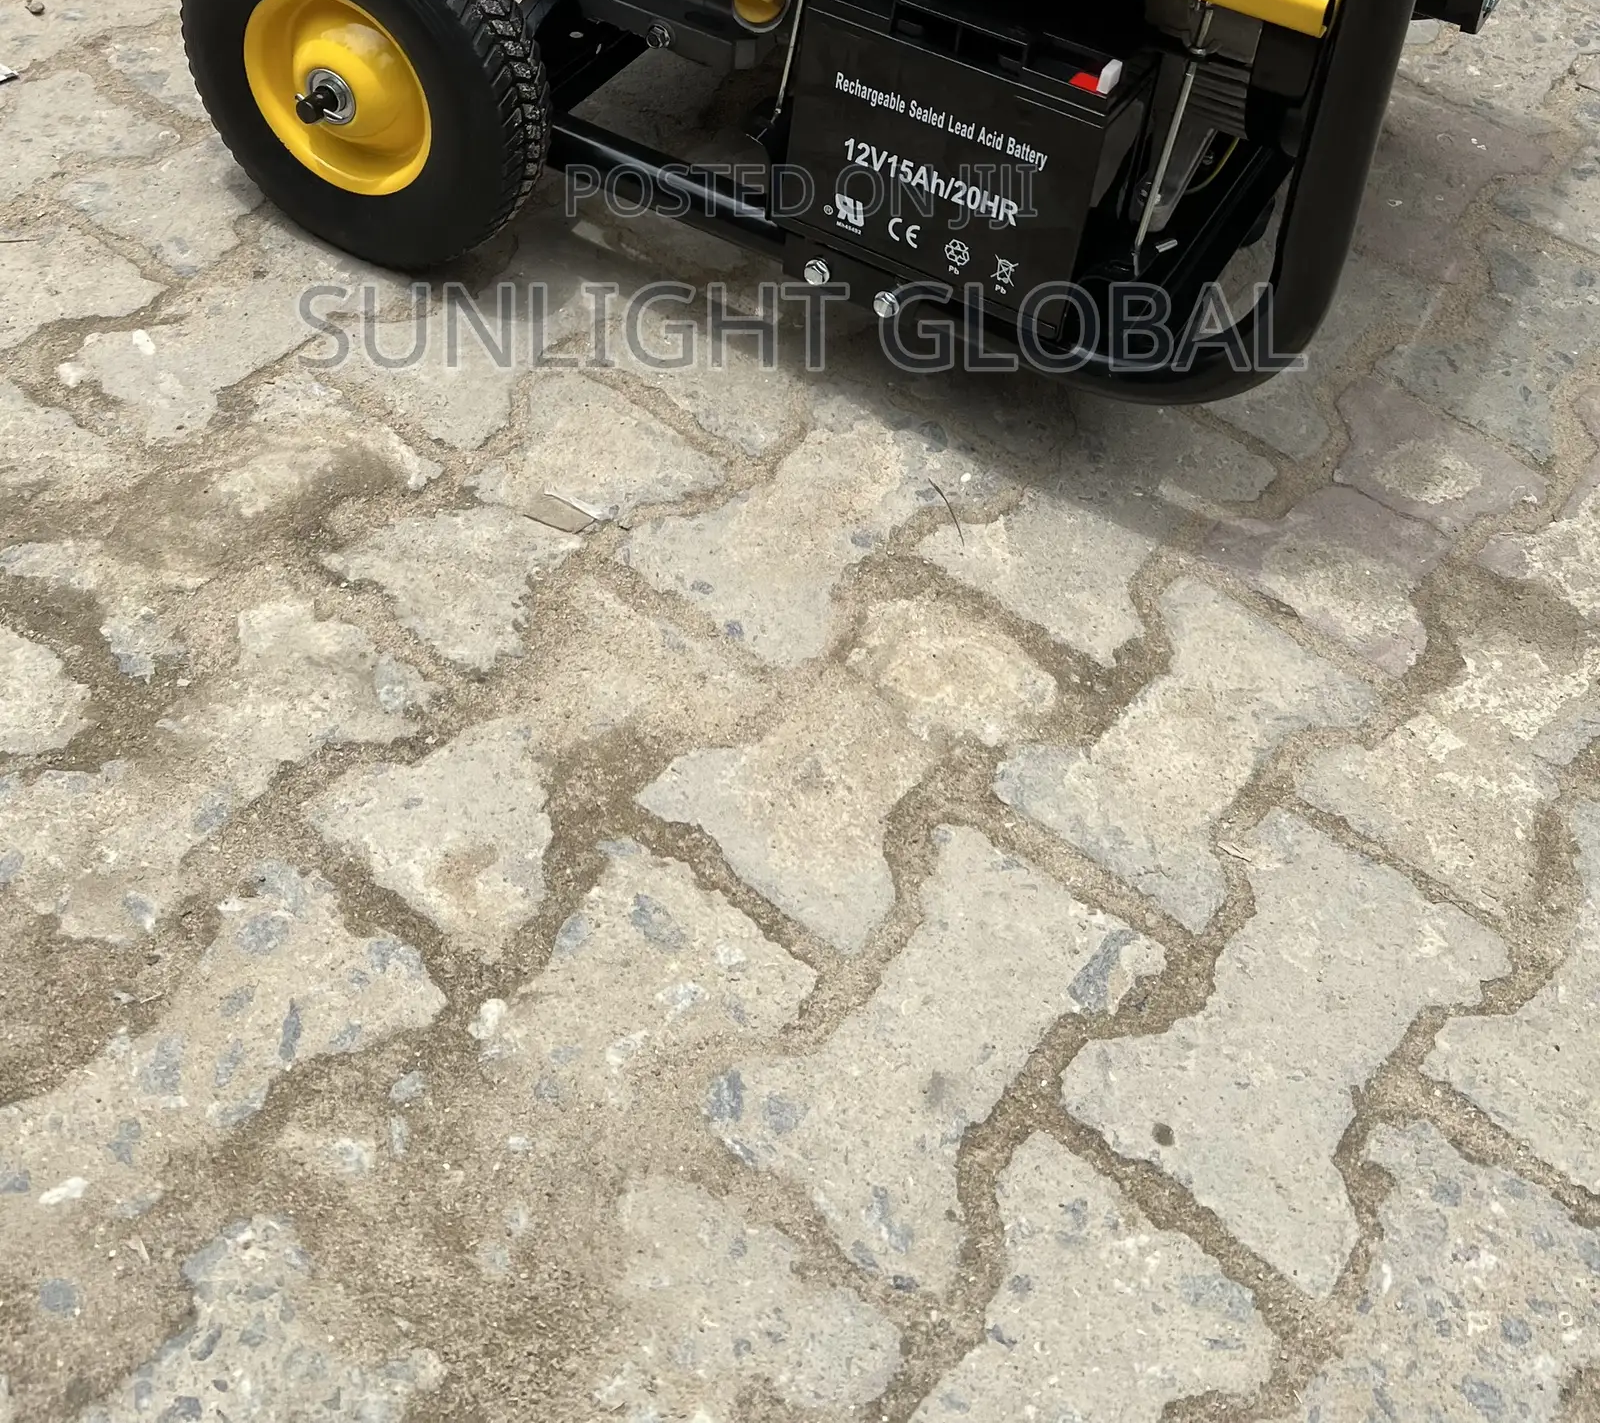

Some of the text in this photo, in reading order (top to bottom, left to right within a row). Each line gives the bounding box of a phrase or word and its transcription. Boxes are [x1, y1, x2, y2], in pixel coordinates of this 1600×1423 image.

[835, 72, 1048, 171] Rechargeable Sealed Lead Acid Battery
[844, 138, 1019, 227] 12V15Ah/20HR
[888, 218, 921, 249] CE
[948, 265, 960, 275] Pb
[994, 284, 1007, 295] Pb
